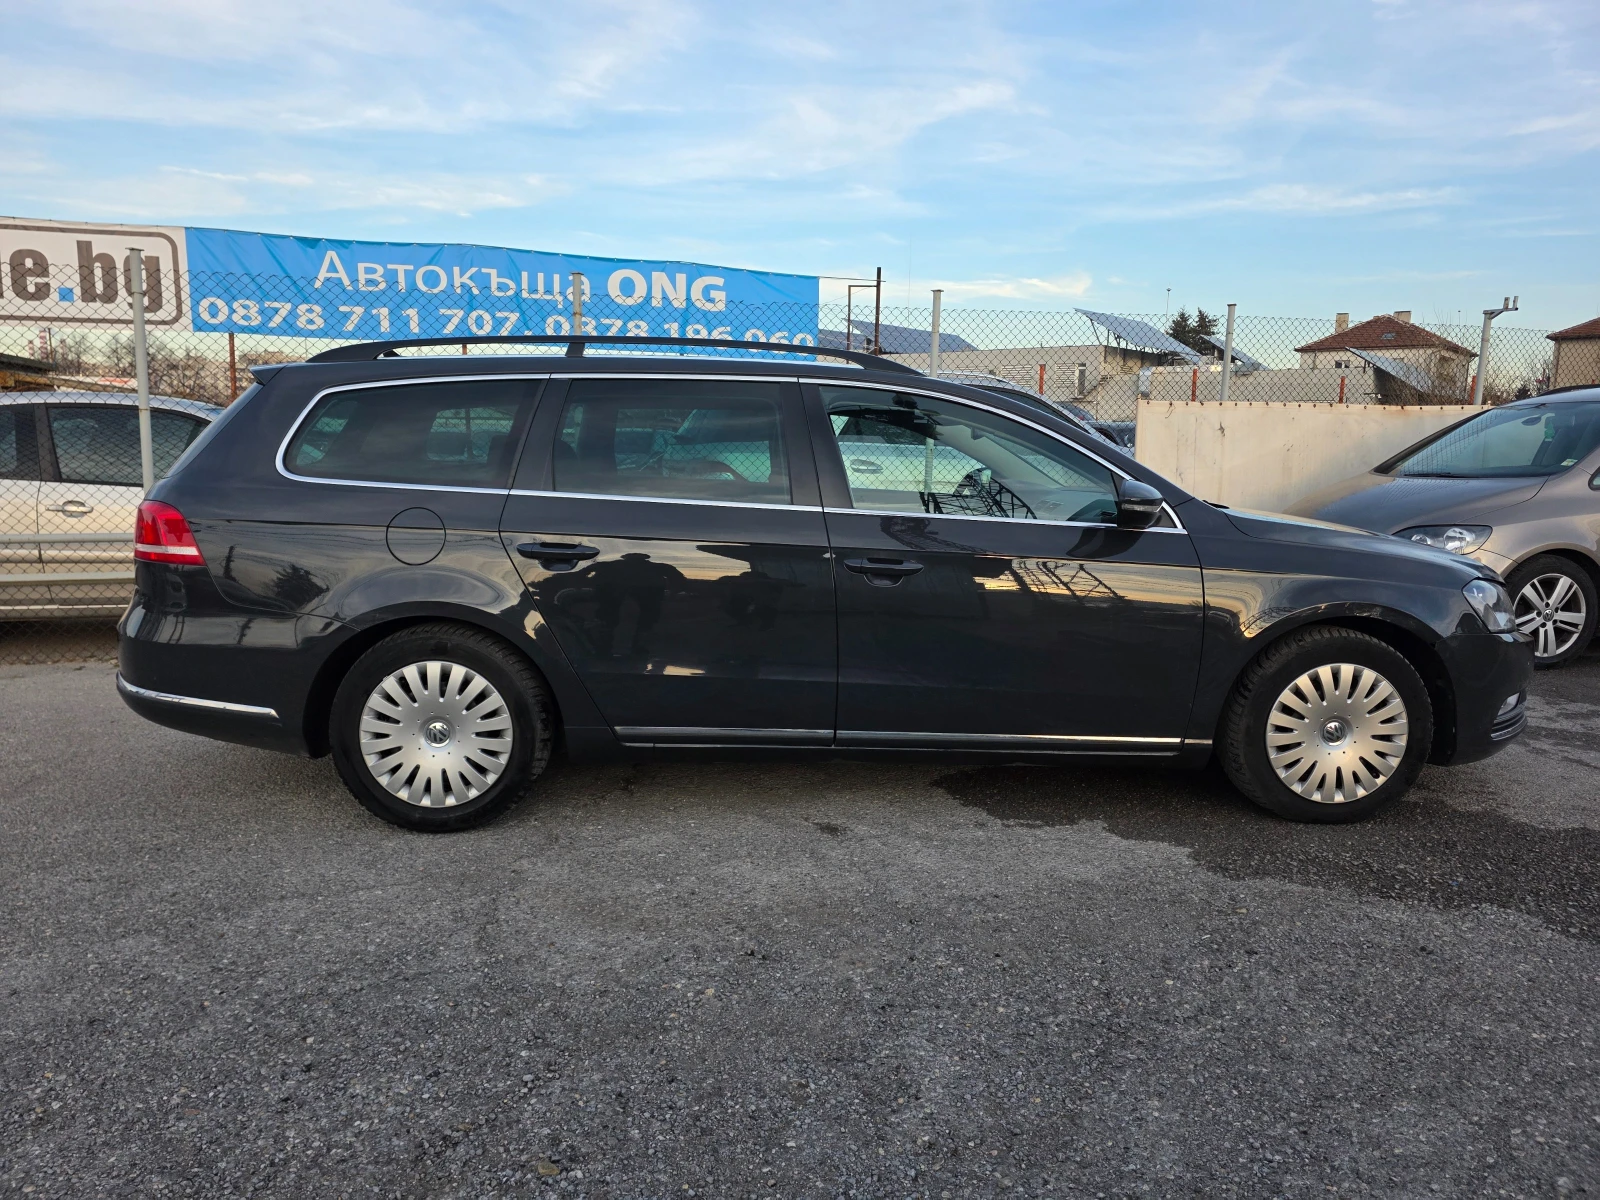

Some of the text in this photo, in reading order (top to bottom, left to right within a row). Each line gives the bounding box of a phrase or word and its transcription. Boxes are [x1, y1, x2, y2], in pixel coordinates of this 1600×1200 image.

[0, 239, 163, 314] e.bg
[313, 250, 727, 312] Автокъща ONG
[198, 297, 325, 331] 0878
[338, 305, 420, 334] 711
